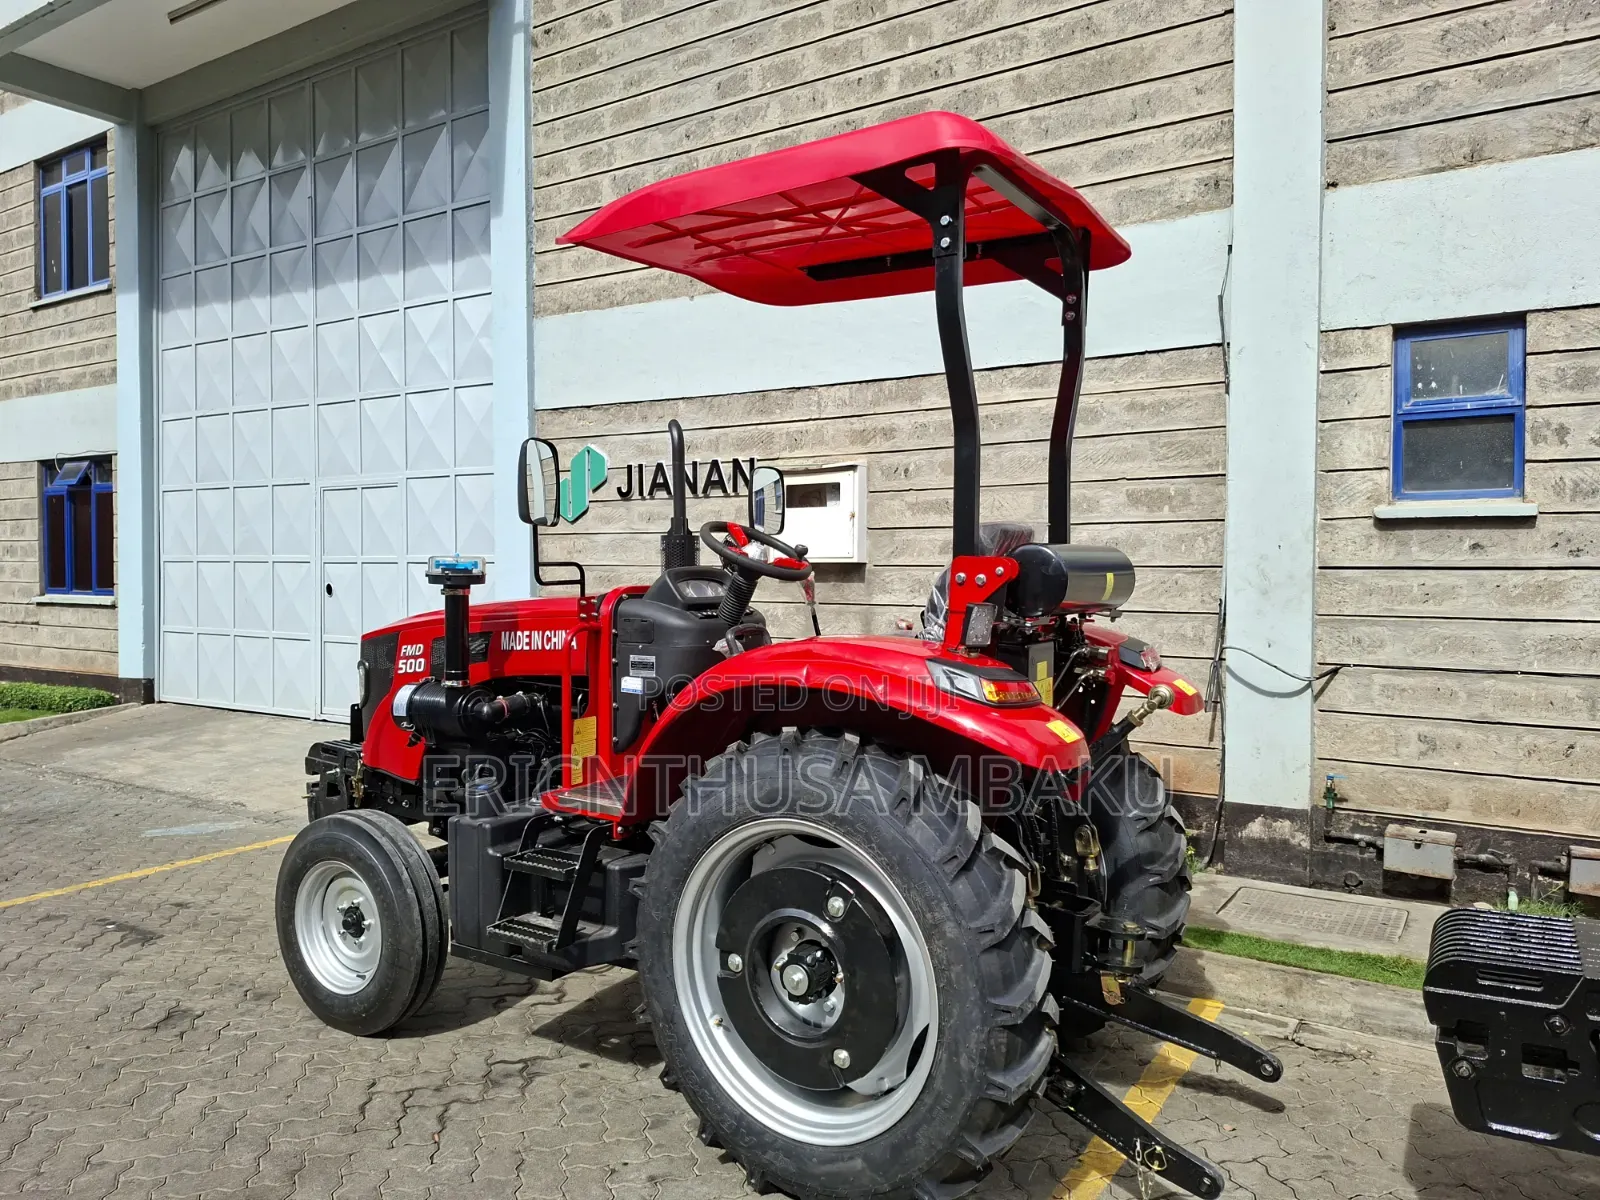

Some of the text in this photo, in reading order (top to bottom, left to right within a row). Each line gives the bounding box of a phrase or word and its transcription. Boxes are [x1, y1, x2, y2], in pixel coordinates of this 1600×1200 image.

[616, 457, 757, 499] JIANAN
[400, 643, 424, 657] FMD
[501, 630, 530, 651] MADE
[531, 630, 543, 651] IN
[397, 657, 426, 674] 500
